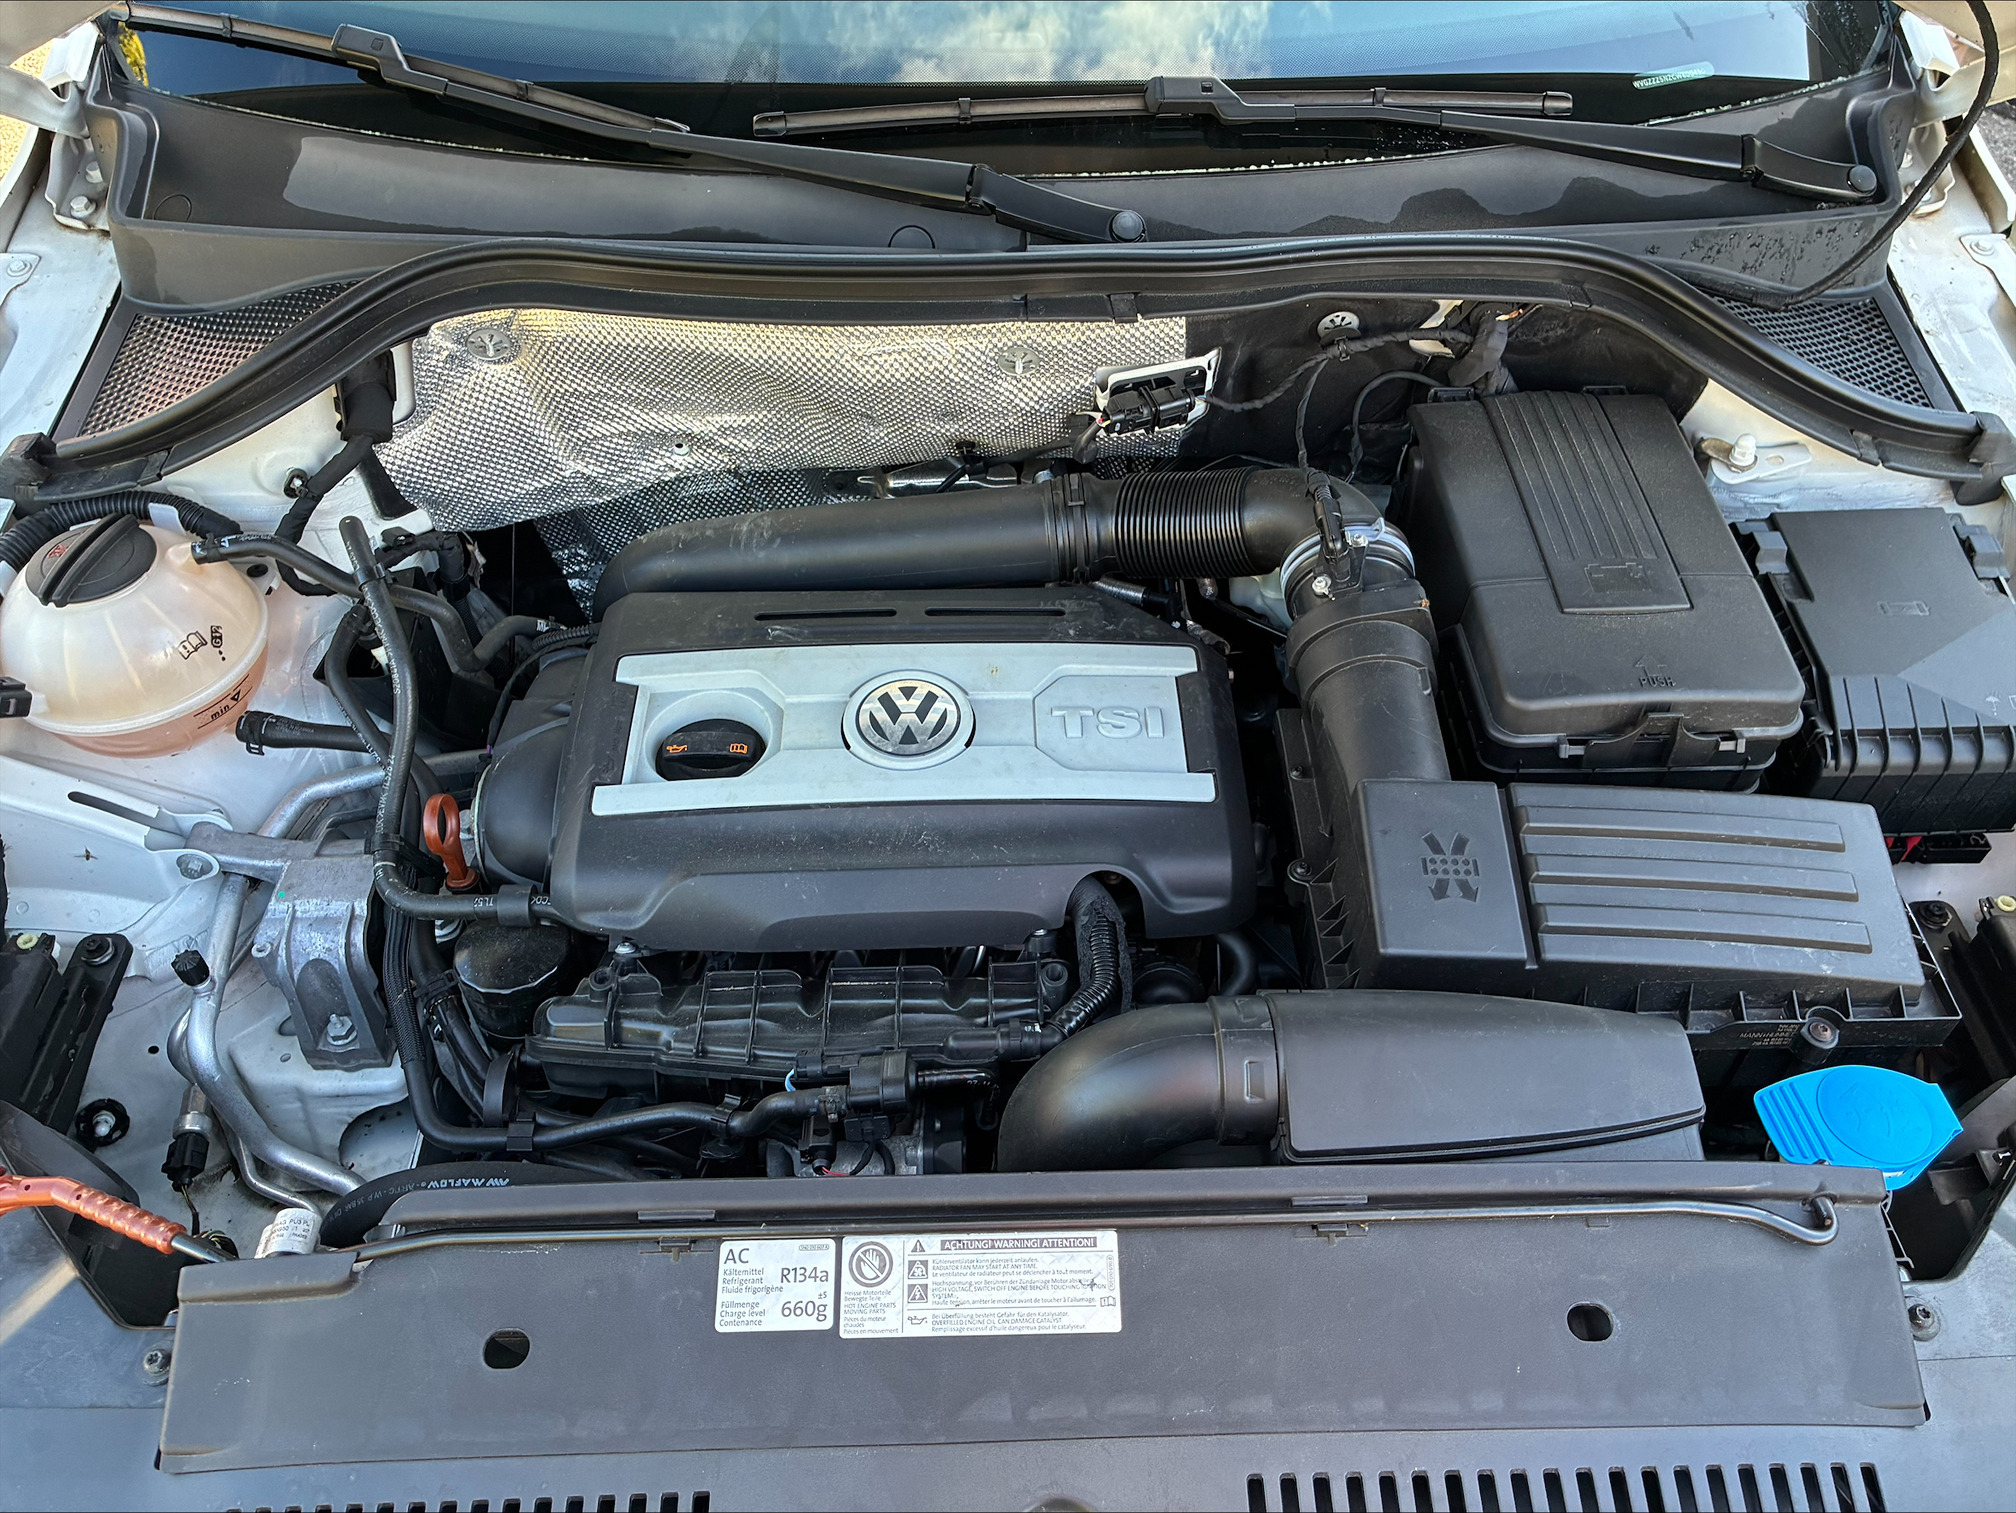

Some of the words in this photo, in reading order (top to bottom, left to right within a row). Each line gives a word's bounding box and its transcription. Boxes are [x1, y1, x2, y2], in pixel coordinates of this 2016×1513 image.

[1638, 676, 1674, 688] PUSH
[210, 704, 230, 720] min
[1050, 706, 1165, 739] TSI
[428, 1178, 486, 1189] MAFLOW
[944, 1240, 992, 1250] ACHTUNG!
[994, 1239, 1041, 1249] WARNING!
[1042, 1238, 1094, 1248] ATTENTION!
[723, 1247, 750, 1265] AC
[723, 1267, 764, 1276] Kältemittel
[780, 1266, 829, 1283] R134a
[722, 1277, 763, 1287] Refrigerant
[721, 1286, 743, 1294] Fluide
[744, 1284, 784, 1295] frigorigène
[721, 1301, 760, 1310] Füllmenge
[781, 1300, 828, 1322] 660g
[720, 1310, 746, 1319] Charge
[748, 1309, 766, 1317] level
[719, 1318, 762, 1327] Contenance
